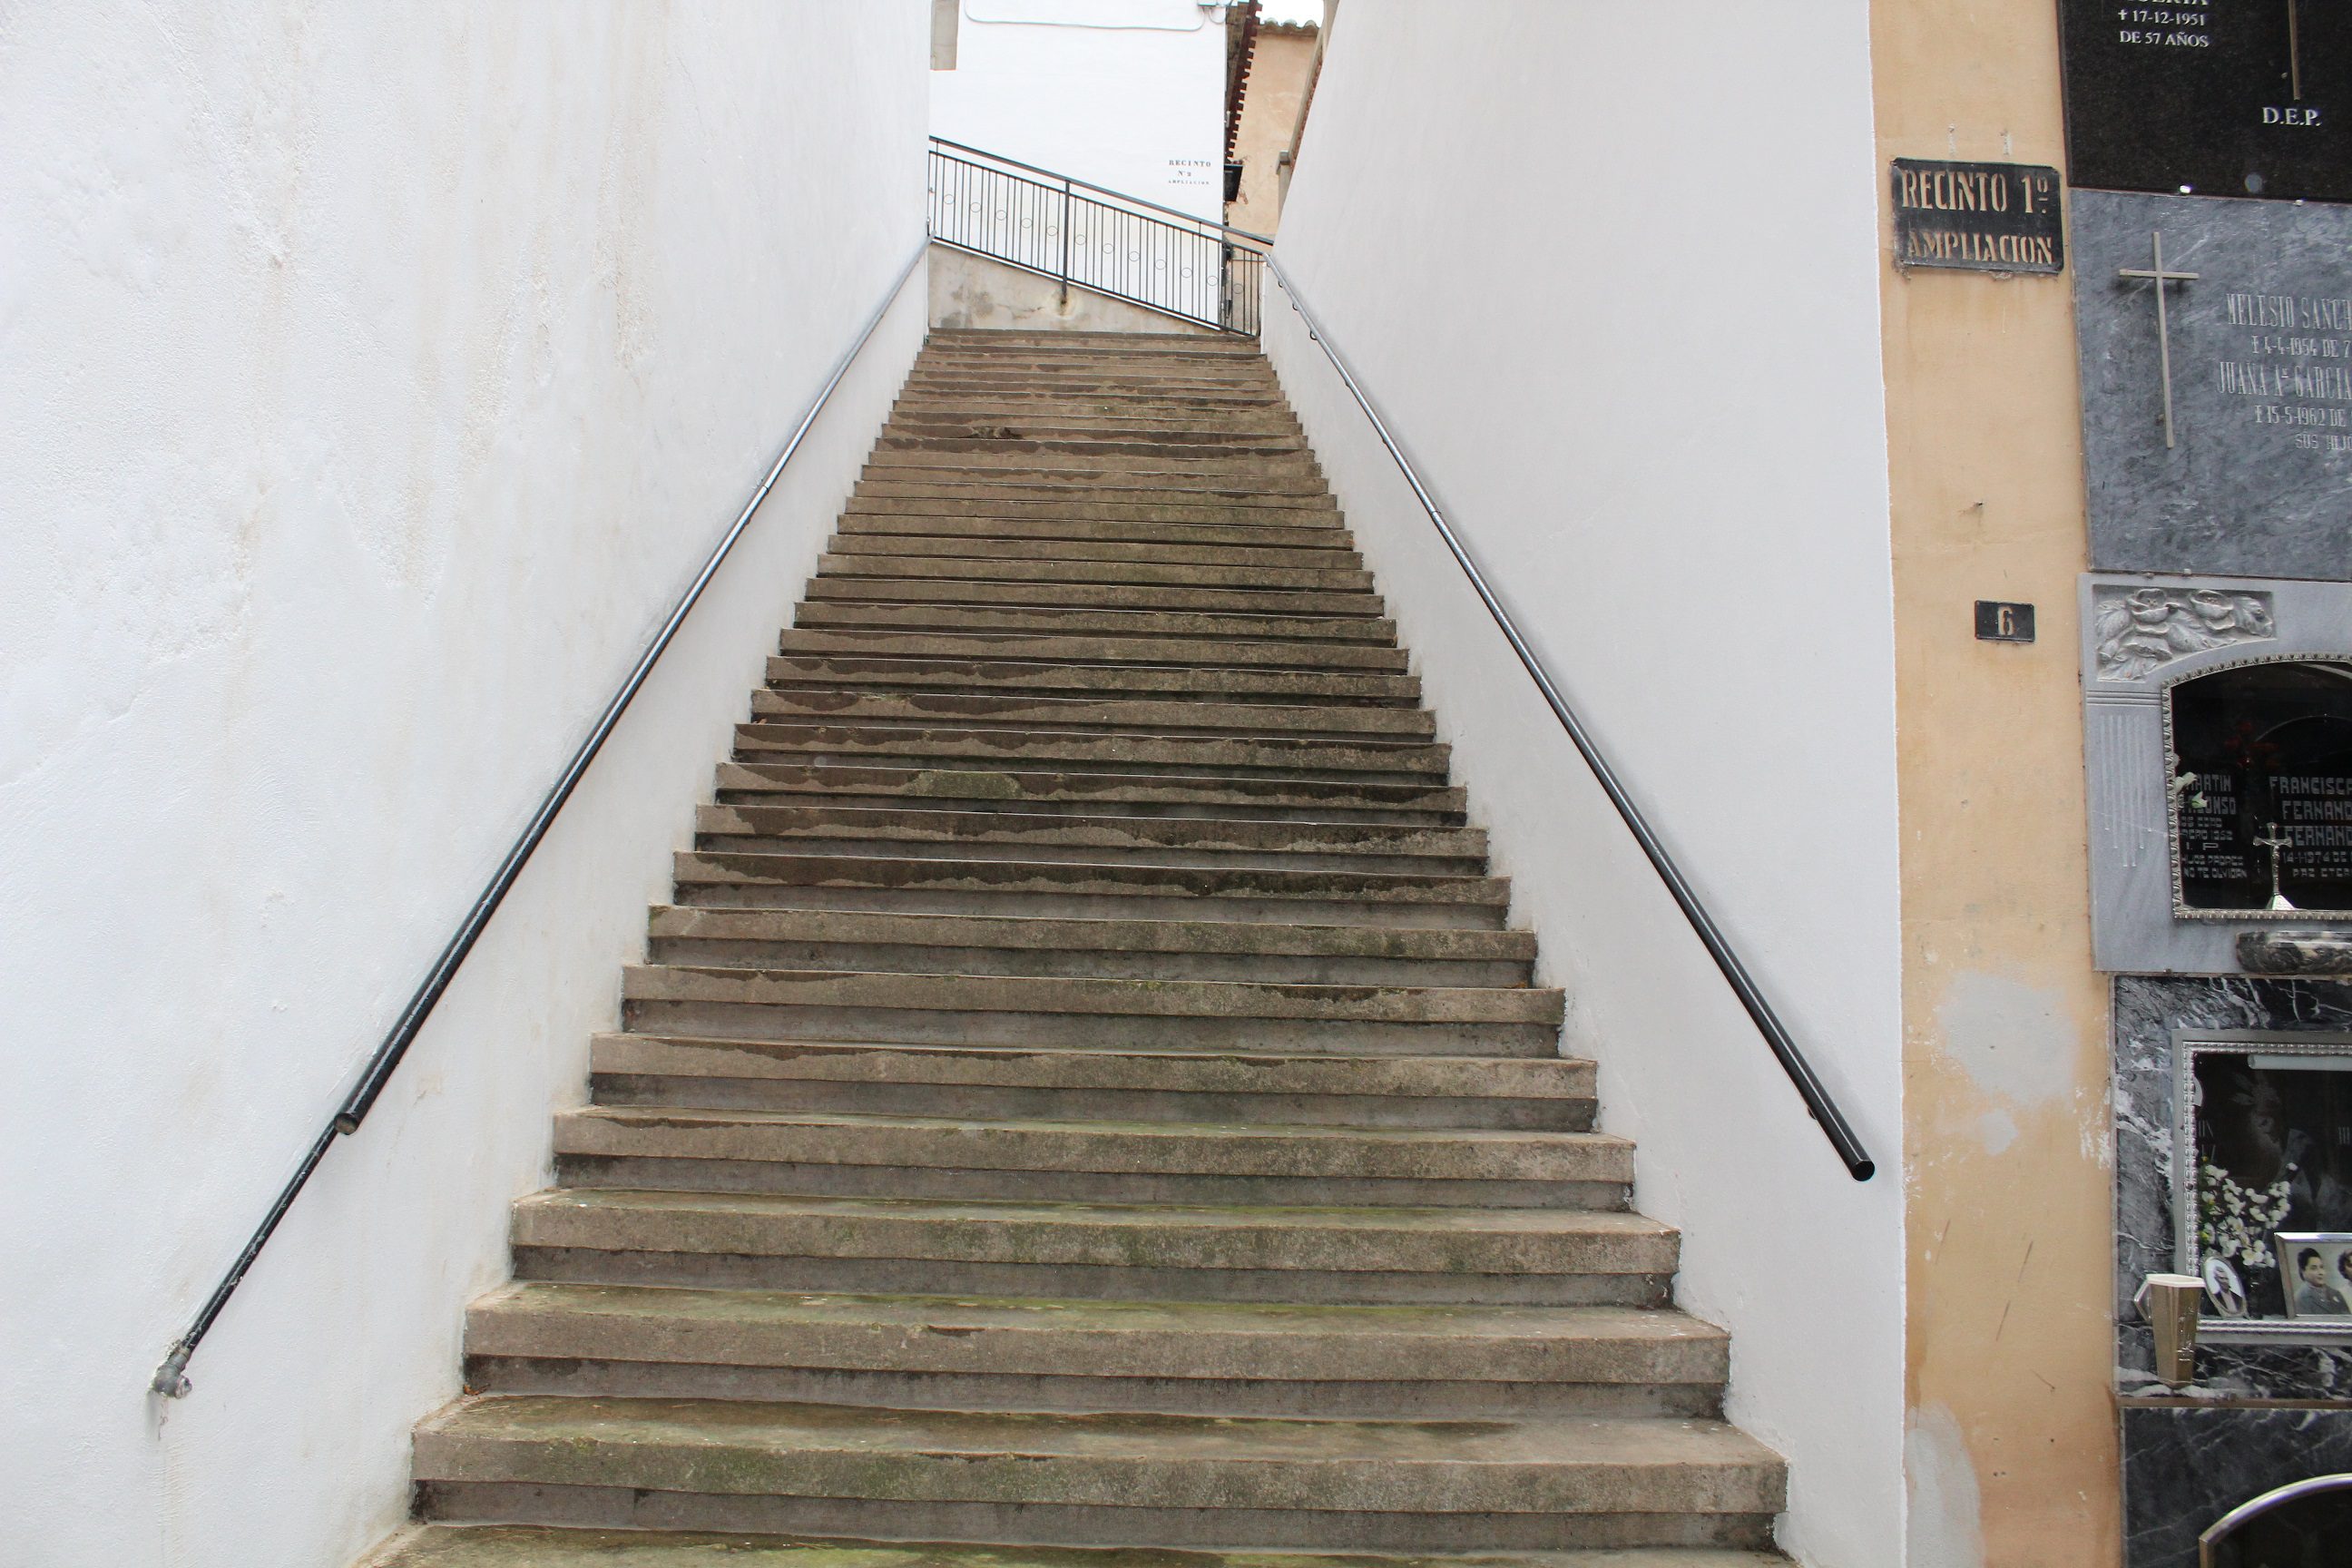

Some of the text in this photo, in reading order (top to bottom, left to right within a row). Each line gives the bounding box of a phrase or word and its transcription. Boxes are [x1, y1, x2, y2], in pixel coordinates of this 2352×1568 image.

[2132, 10, 2205, 26] 17-12-1951
[2120, 30, 2210, 48] DE 57 AÑOS
[2262, 107, 2322, 127] D.E.P.
[1169, 160, 1211, 168] RECINTO
[1901, 169, 2008, 212] RECINTO
[1908, 230, 2053, 265] AMPLIACION
[2226, 293, 2295, 328] MELESIO
[2264, 336, 2318, 357] 4-4-1954
[2322, 338, 2339, 358] DE
[2218, 361, 2269, 396] JUANA
[2267, 405, 2347, 427] 15-5-1962 DE
[1998, 605, 2015, 636] 6
